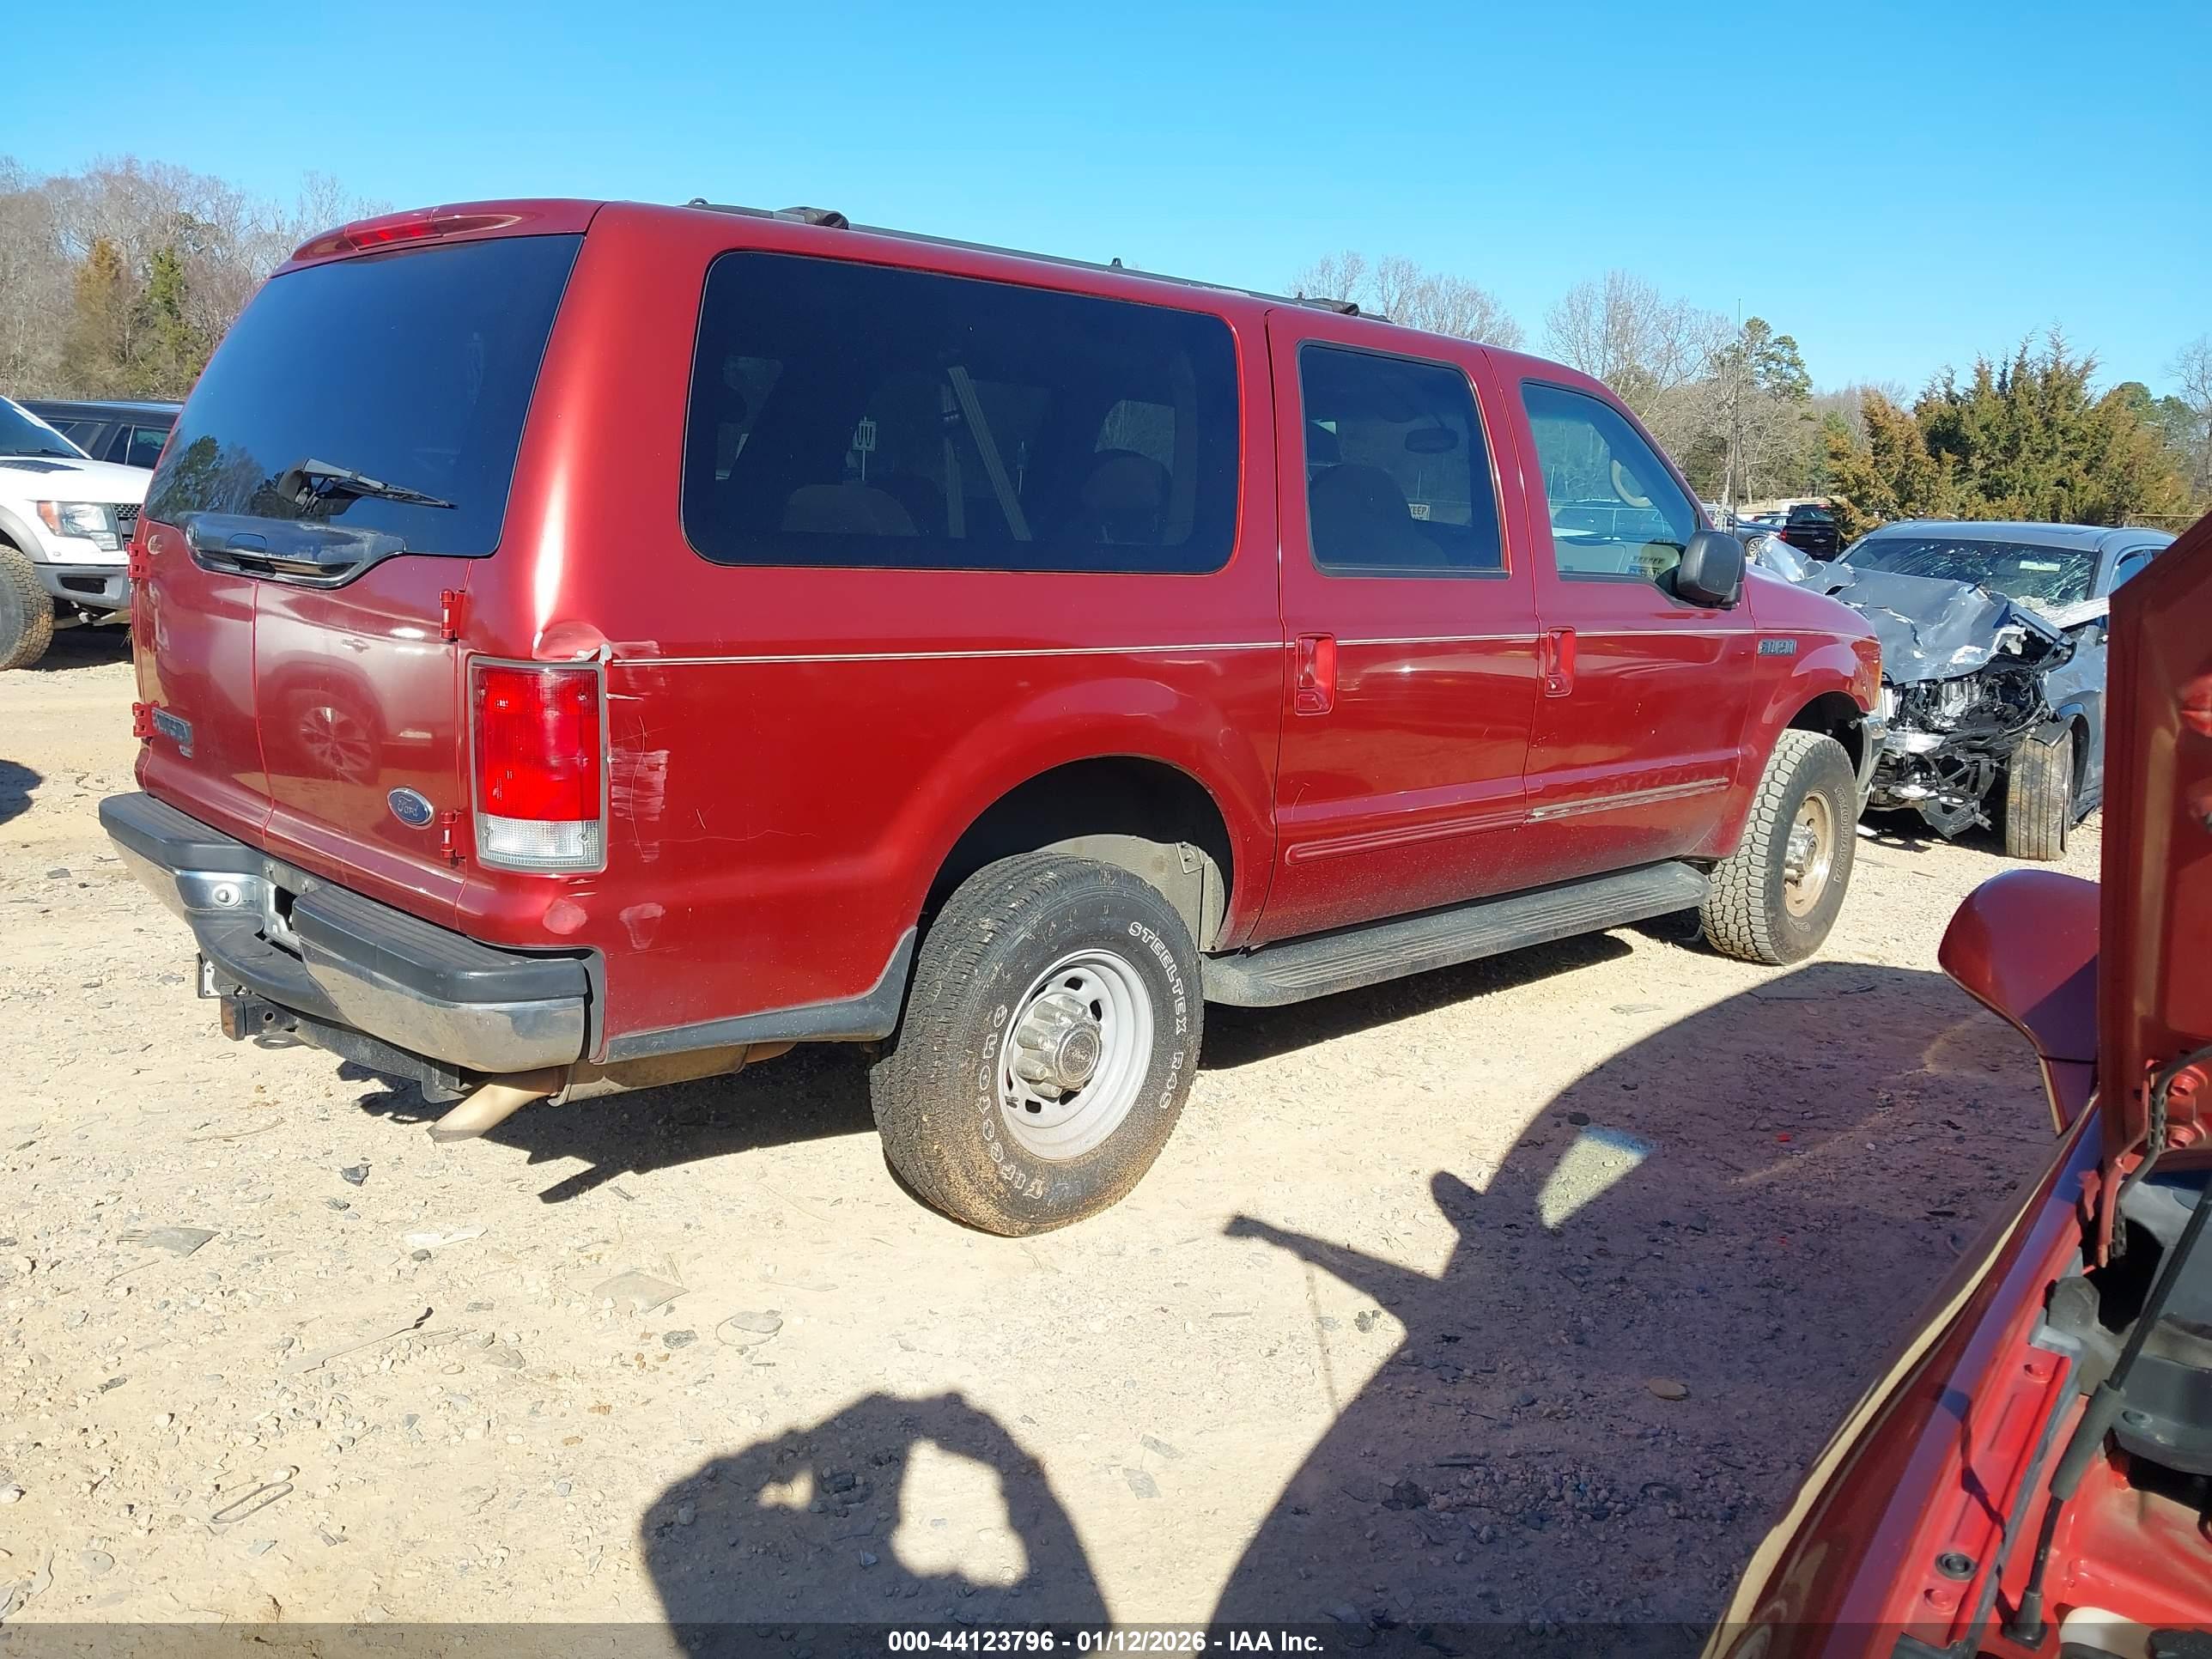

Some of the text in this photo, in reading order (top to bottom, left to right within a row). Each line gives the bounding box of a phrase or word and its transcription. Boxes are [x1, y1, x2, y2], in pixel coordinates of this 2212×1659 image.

[398, 795, 419, 817] Ford
[977, 1005, 1043, 1200] Firestone
[1128, 921, 1187, 1109] STEELTEX R4S
